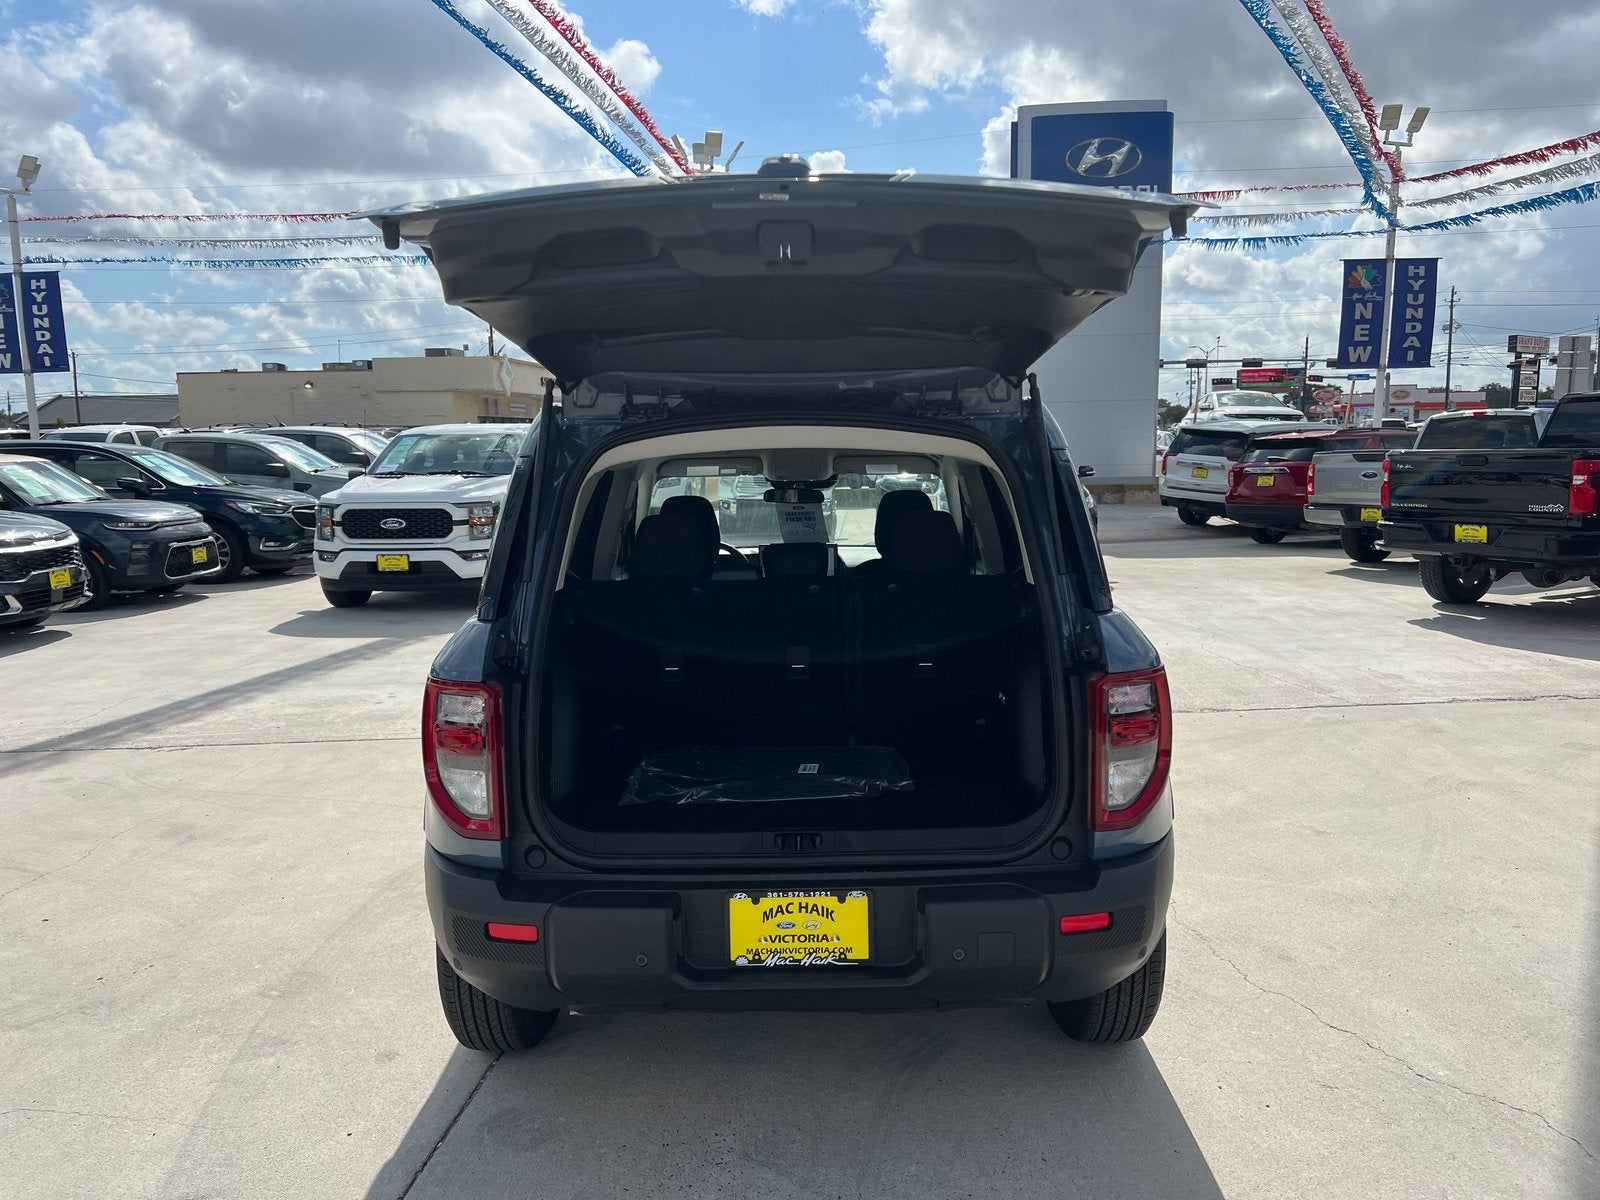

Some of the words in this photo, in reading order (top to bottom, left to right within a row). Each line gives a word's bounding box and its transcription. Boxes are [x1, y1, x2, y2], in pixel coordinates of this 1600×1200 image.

[30, 278, 54, 367] HYUNDAI
[1347, 302, 1373, 363] NEW
[1402, 265, 1426, 362] HYUNDAI
[762, 902, 794, 923] MAC
[798, 901, 835, 922] HAIK
[764, 952, 799, 966] Mac
[800, 952, 838, 966] Haik
[768, 934, 830, 944] VICTORIA
